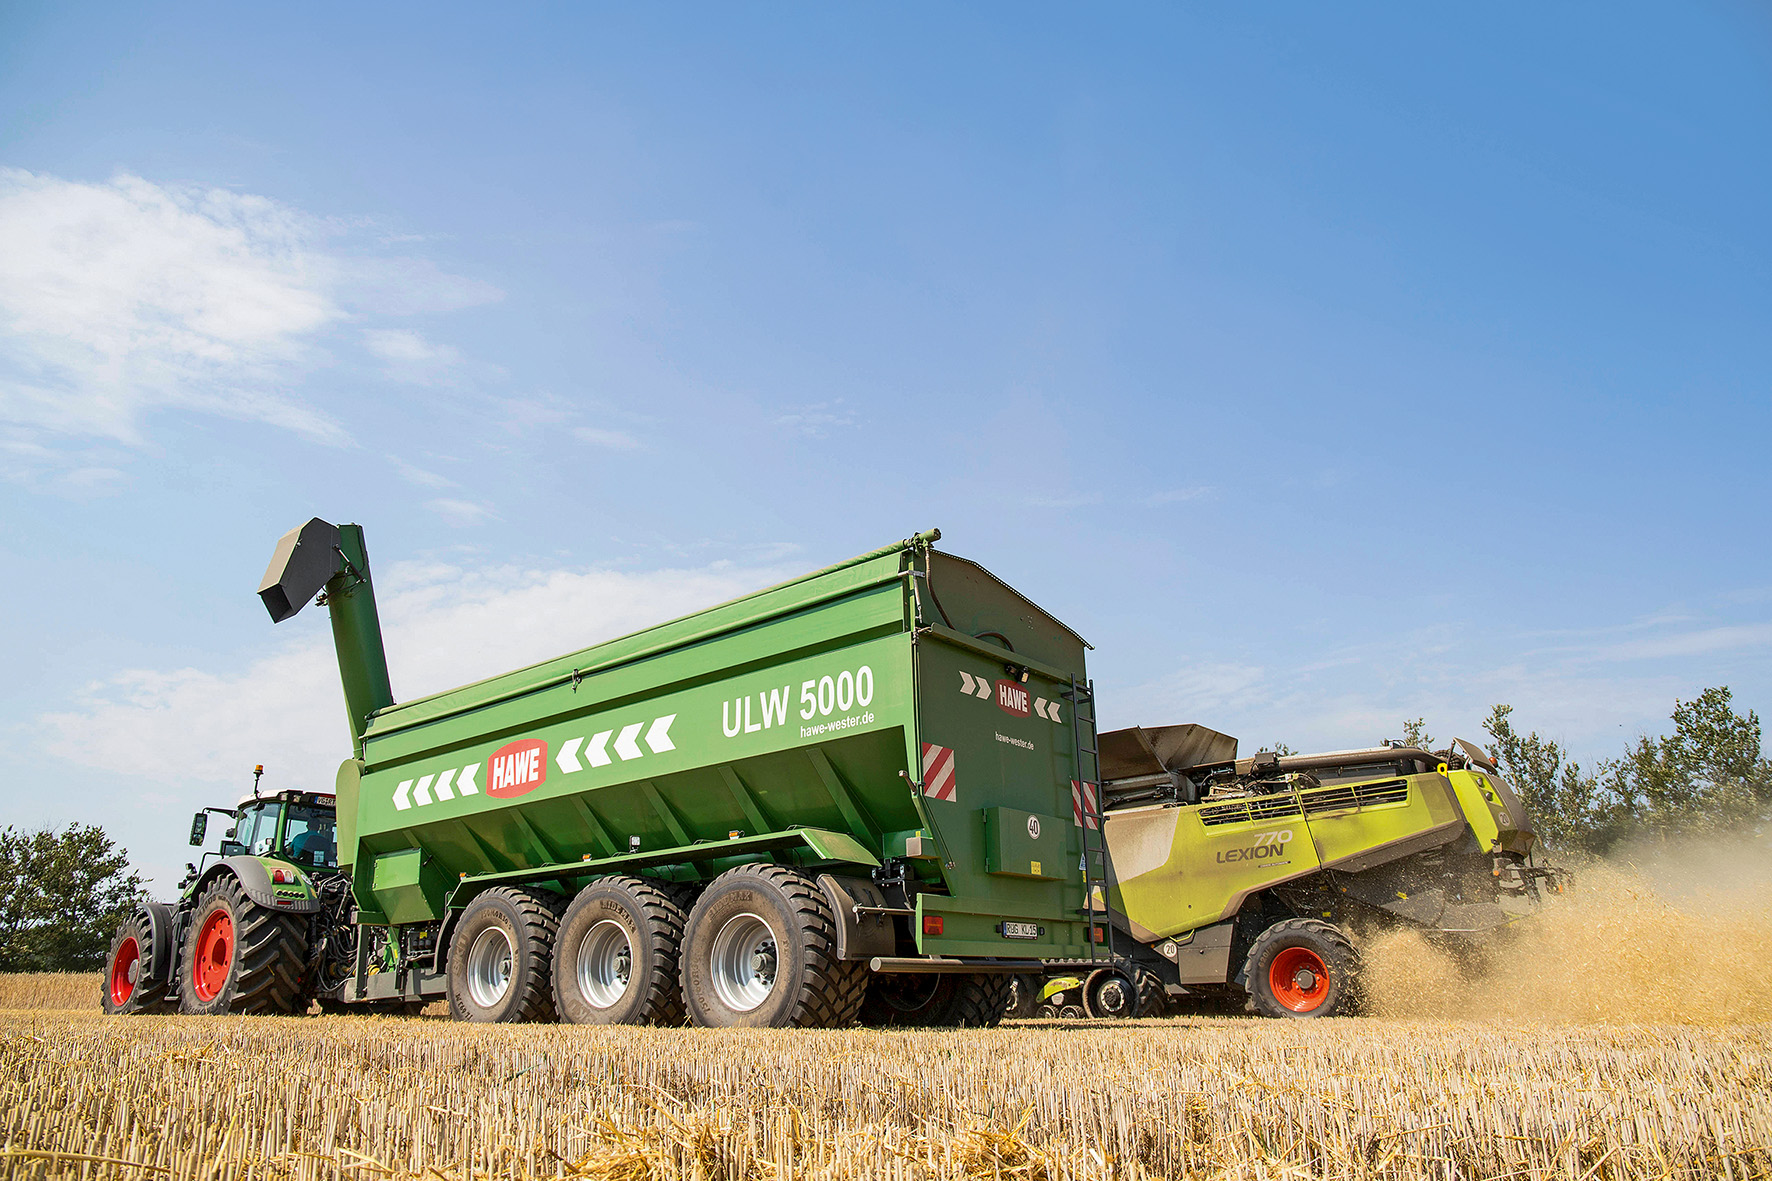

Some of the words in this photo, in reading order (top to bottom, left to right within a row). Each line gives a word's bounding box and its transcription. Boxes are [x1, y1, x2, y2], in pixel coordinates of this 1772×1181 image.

[722, 685, 790, 738] ULW
[800, 665, 874, 720] 5000
[999, 684, 1028, 713] HAWE
[800, 711, 875, 738] hawe-wester.de
[491, 748, 541, 790] HAWE
[1029, 819, 1039, 835] 40
[1254, 829, 1293, 847] 770
[1216, 843, 1284, 864] LEXION
[1165, 944, 1175, 955] 20
